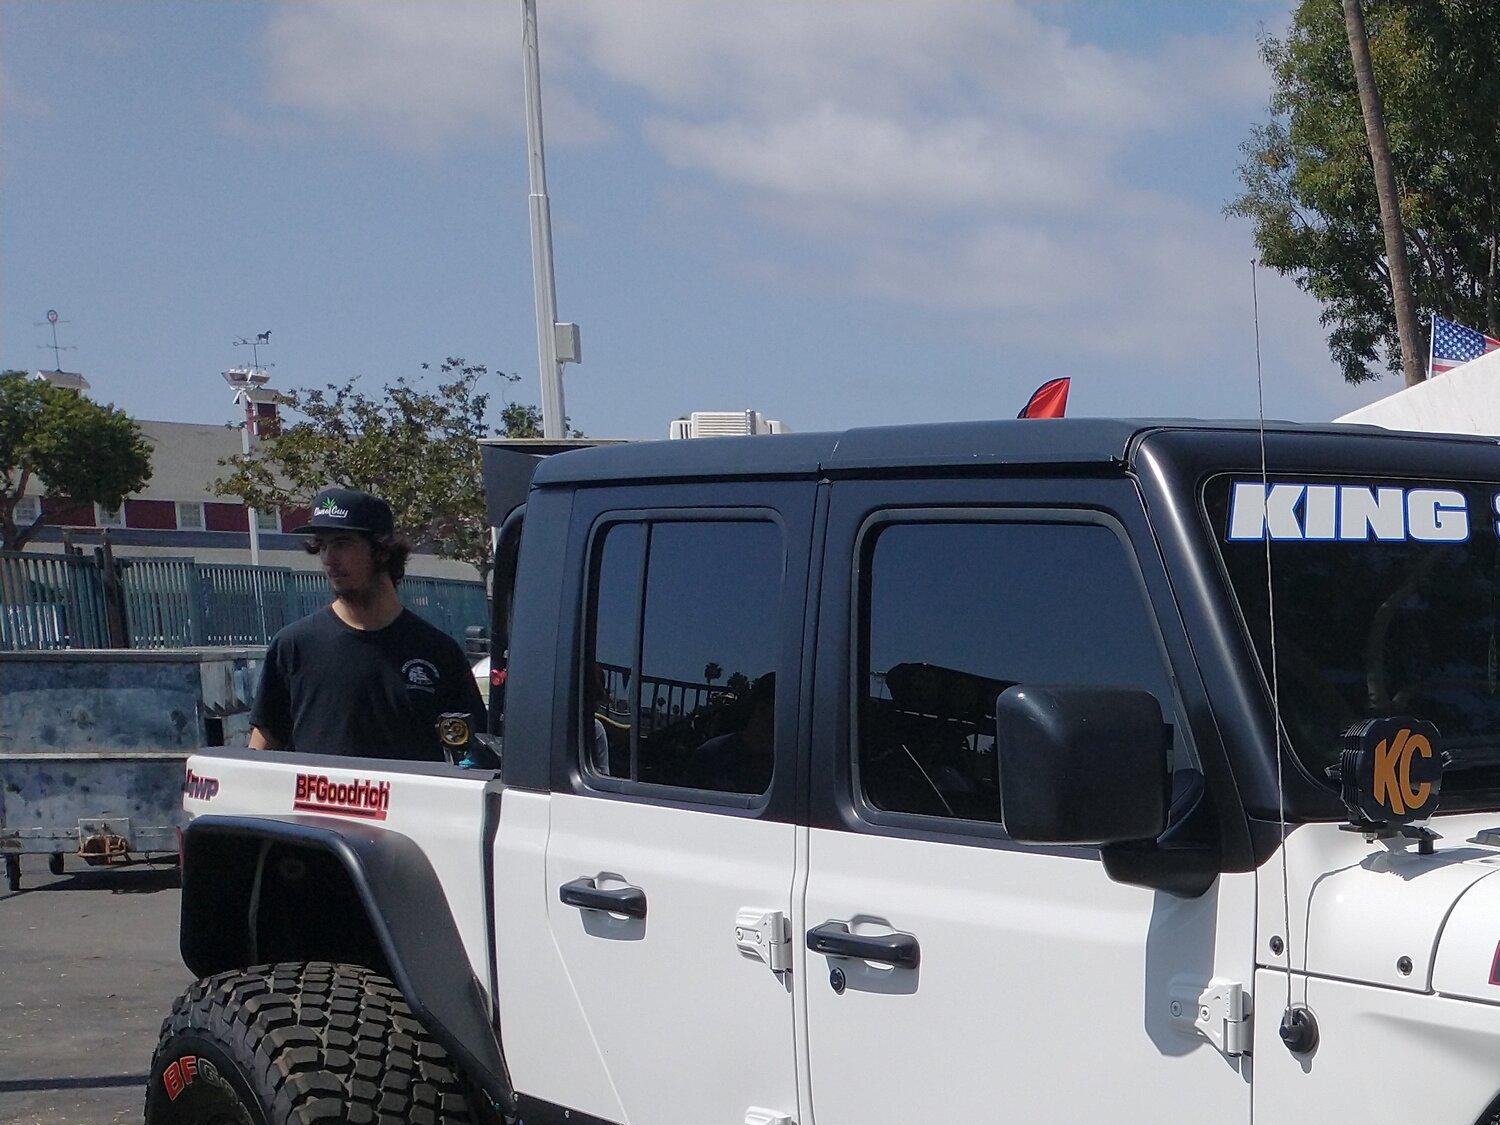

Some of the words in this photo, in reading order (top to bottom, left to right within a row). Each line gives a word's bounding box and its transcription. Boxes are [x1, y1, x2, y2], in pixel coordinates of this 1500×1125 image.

[1226, 480, 1470, 543] KING
[296, 773, 390, 810] BFGoodrich
[1373, 728, 1432, 815] KC
